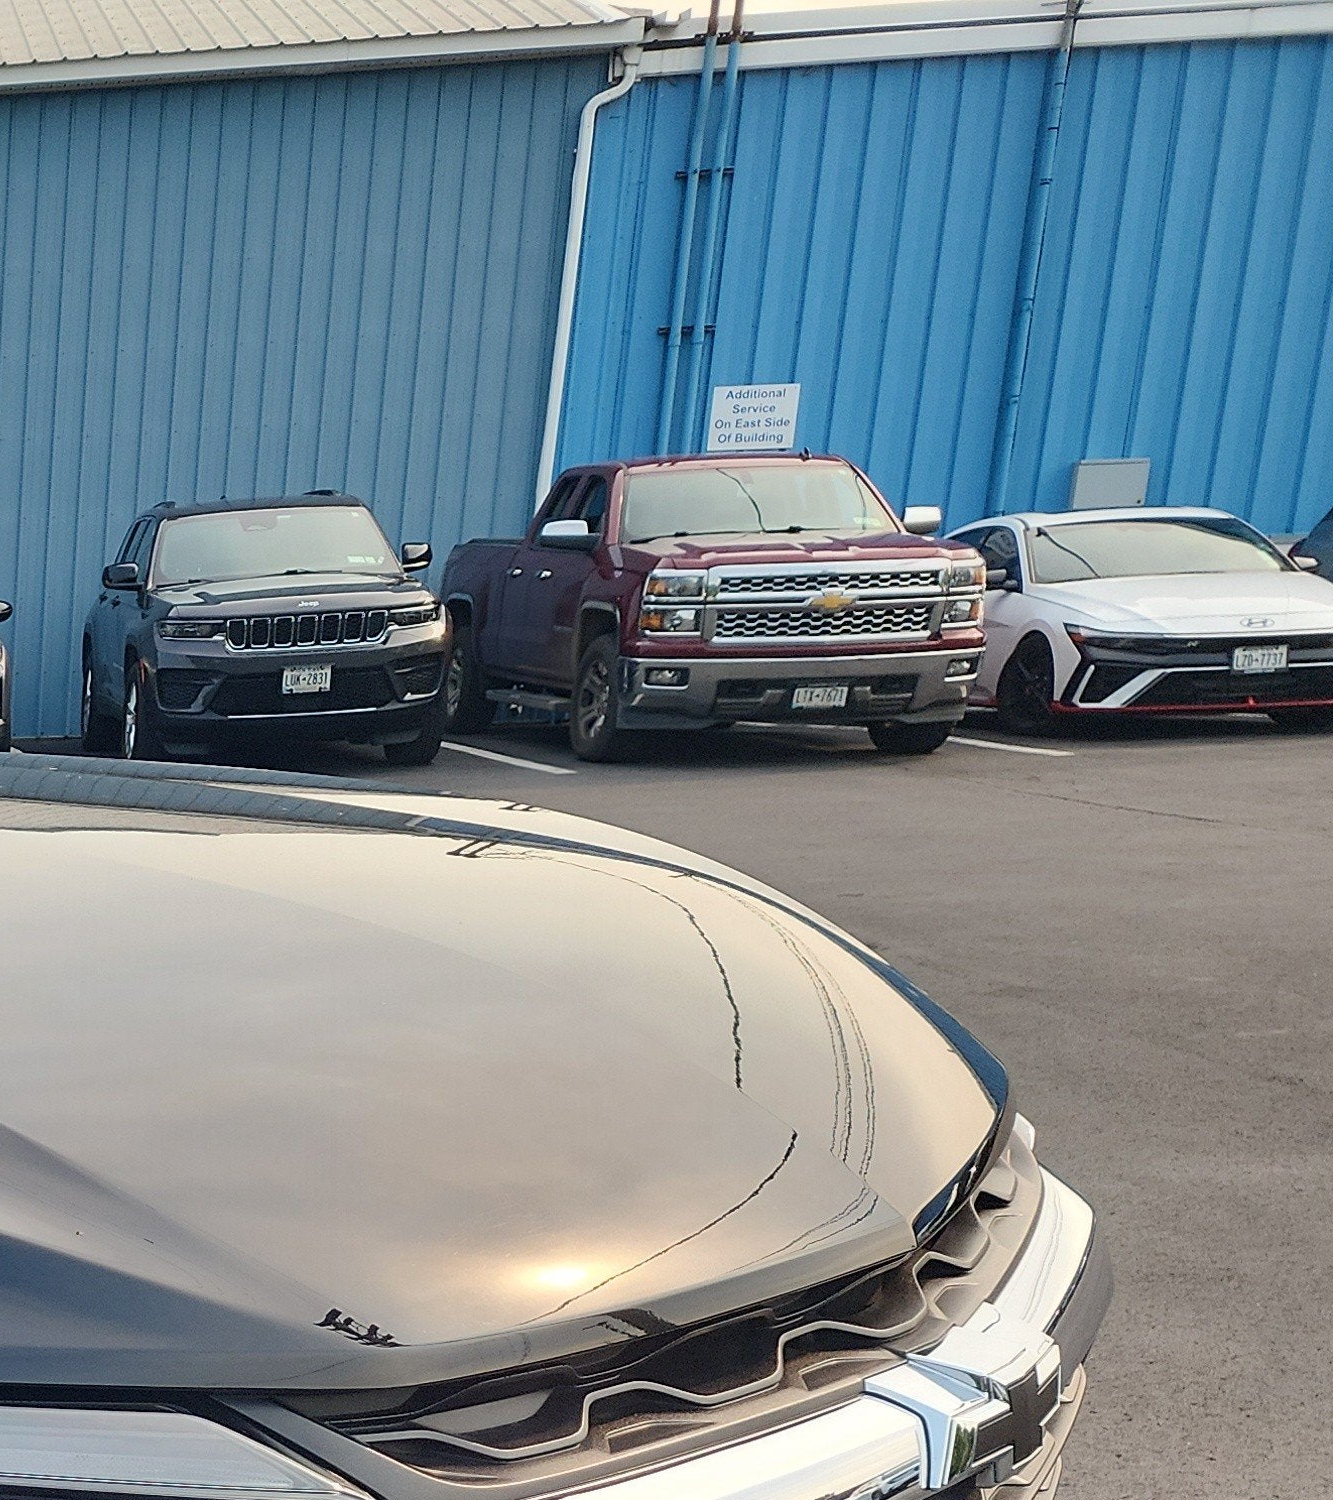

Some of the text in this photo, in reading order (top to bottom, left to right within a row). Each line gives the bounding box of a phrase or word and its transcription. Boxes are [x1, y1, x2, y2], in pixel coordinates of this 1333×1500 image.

[725, 388, 787, 400] Additional
[732, 403, 776, 414] Service
[714, 416, 791, 429] On East Side
[717, 432, 784, 444] Of Building
